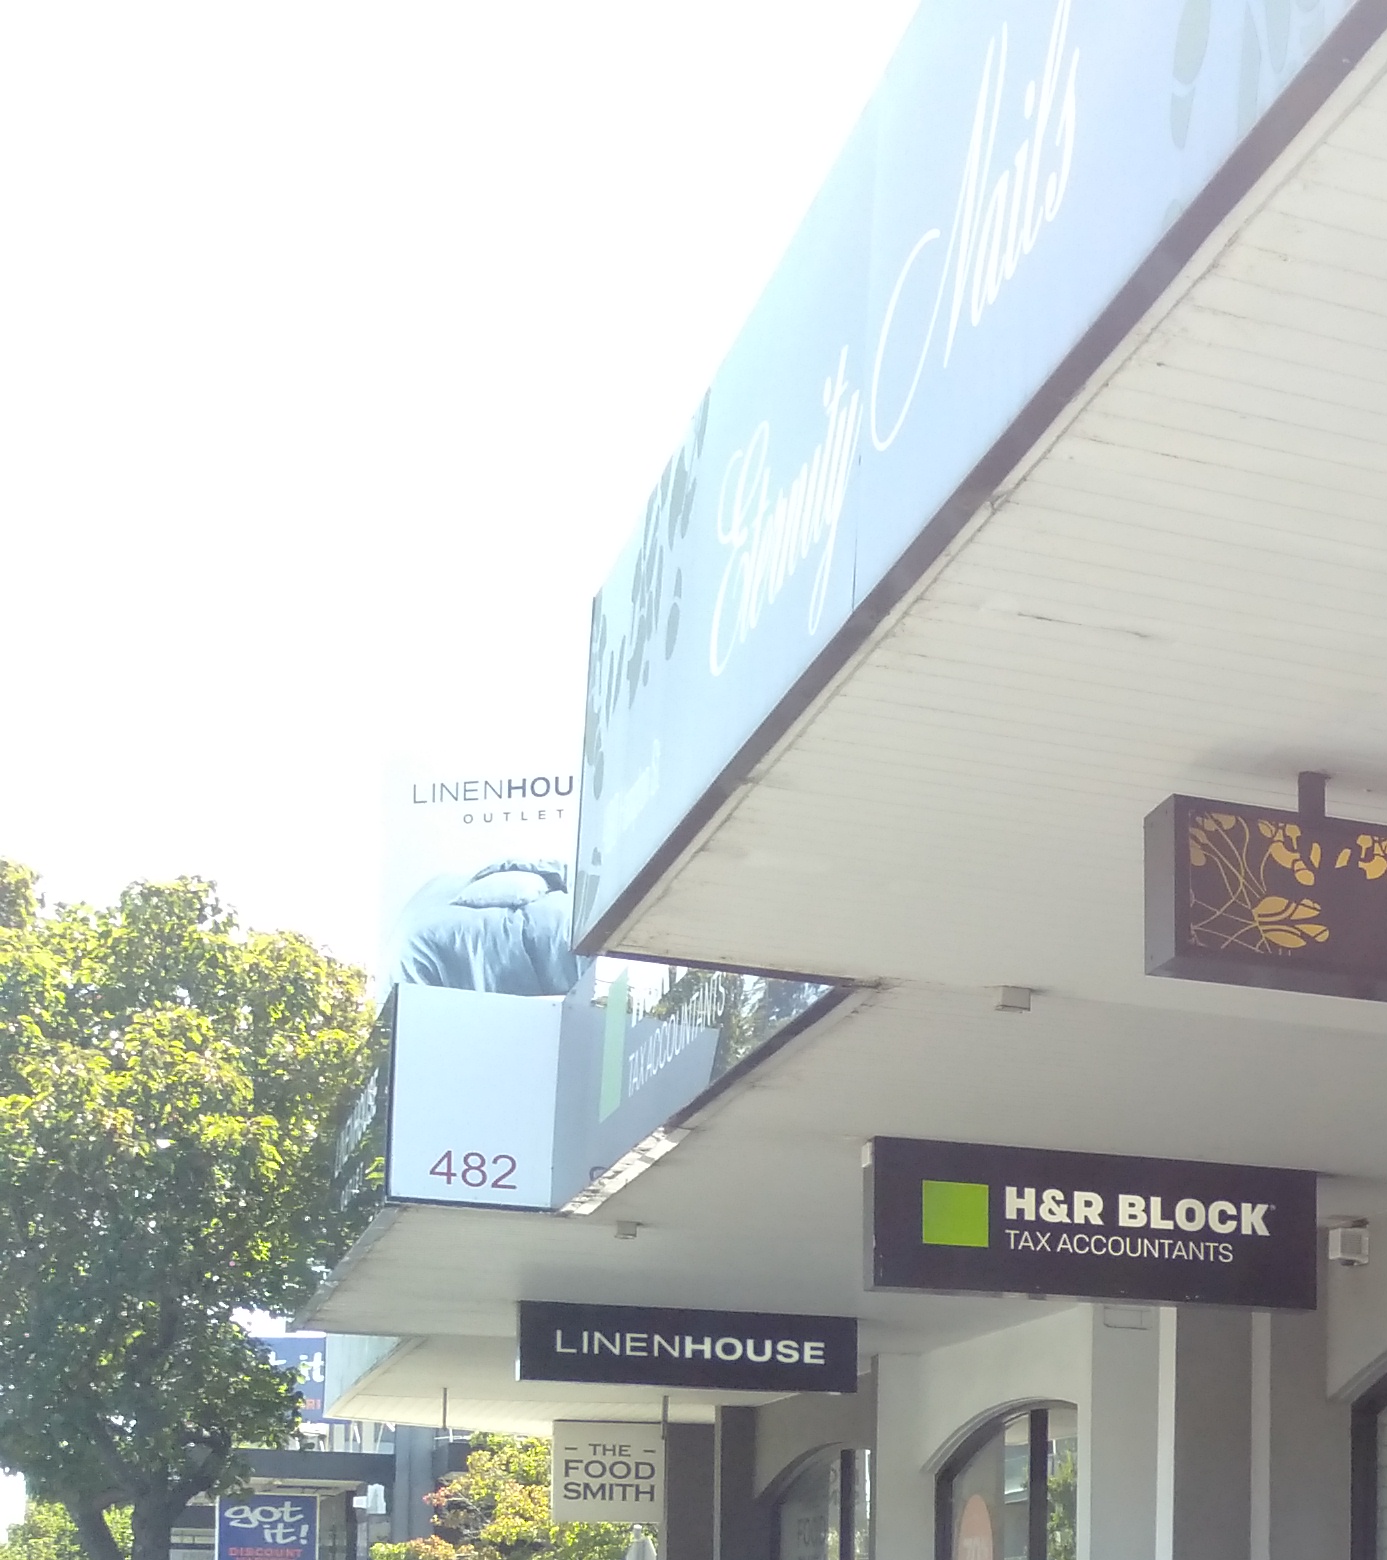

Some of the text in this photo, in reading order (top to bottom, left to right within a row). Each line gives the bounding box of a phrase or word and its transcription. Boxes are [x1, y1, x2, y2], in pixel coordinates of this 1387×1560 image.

[709, 0, 1079, 678] Eternity Nails
[412, 775, 574, 804] LINENHOU
[463, 808, 565, 824] OUTLET
[429, 1149, 518, 1190] 482
[1004, 1185, 1271, 1237] H&R BLOCK
[1005, 1229, 1234, 1264] TAX ACCOUNTANTS
[555, 1329, 826, 1365] LINENHOUSE
[588, 1442, 631, 1457] THE
[563, 1459, 656, 1480] FOOD
[563, 1481, 656, 1502] SMITH
[224, 1500, 305, 1528] got
[262, 1524, 310, 1545] it!
[228, 1546, 304, 1558] DISCOUNT
